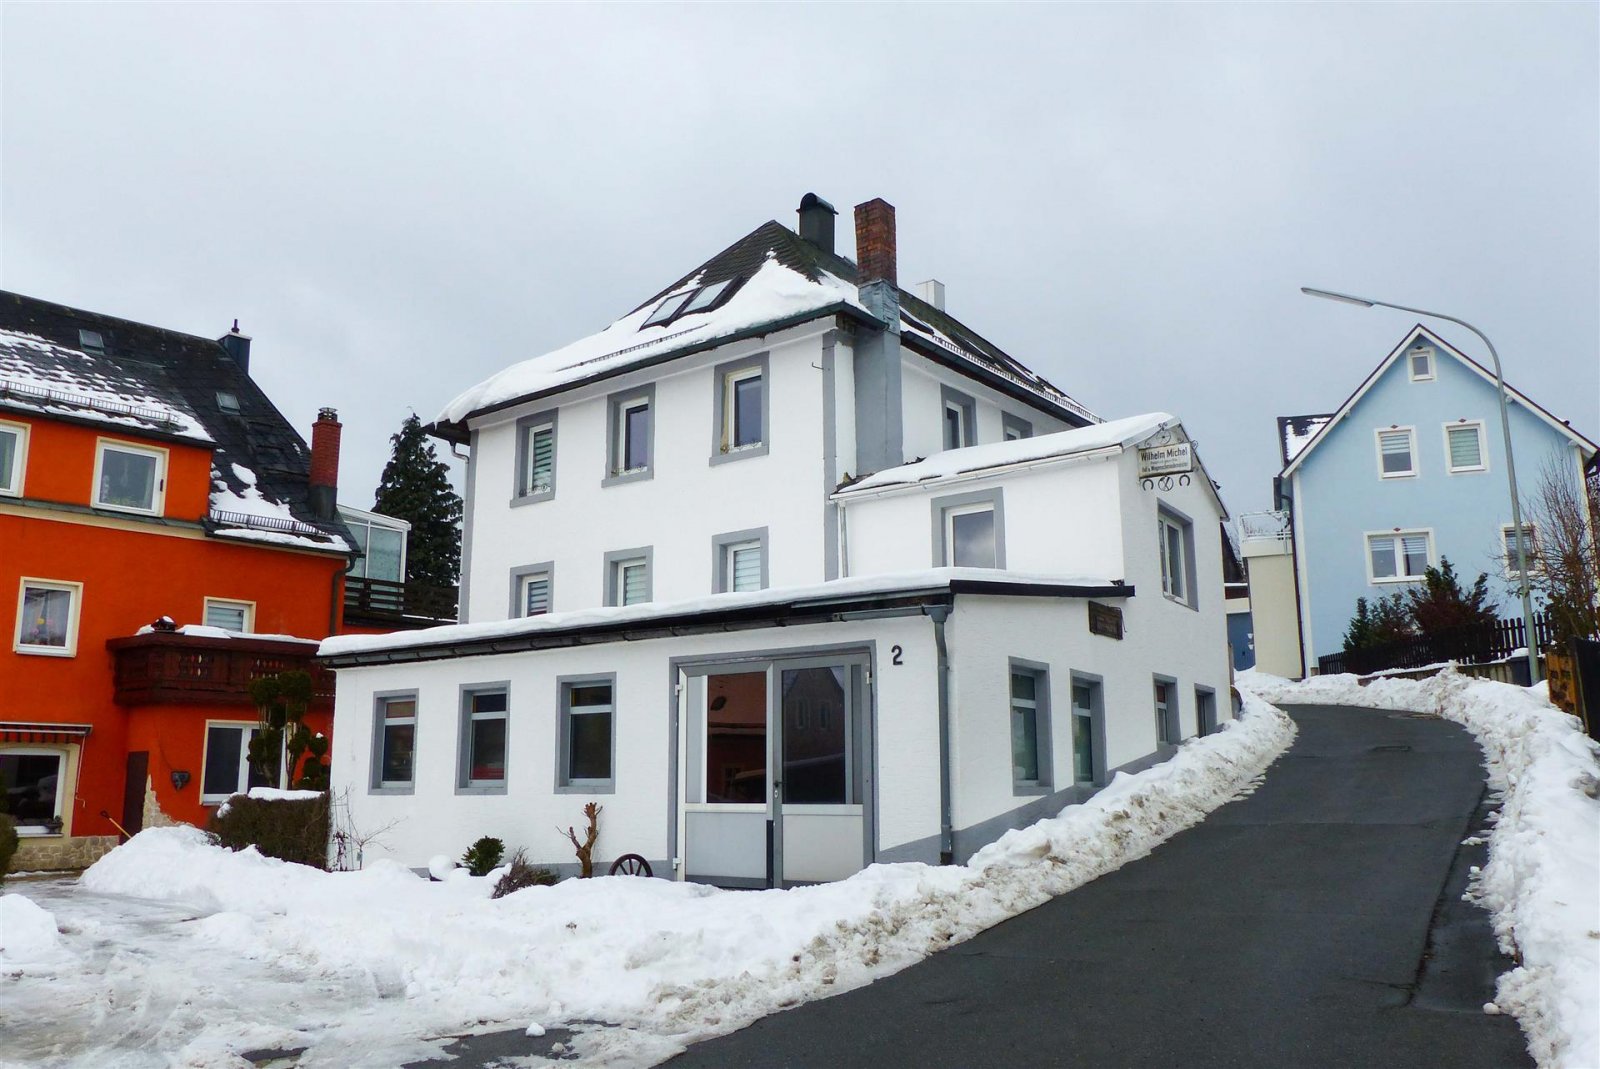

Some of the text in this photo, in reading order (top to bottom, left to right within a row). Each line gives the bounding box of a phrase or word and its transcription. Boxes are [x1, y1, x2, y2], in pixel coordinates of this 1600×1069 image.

[1141, 447, 1188, 461] Wilhelm Michel
[891, 645, 903, 665] 2
